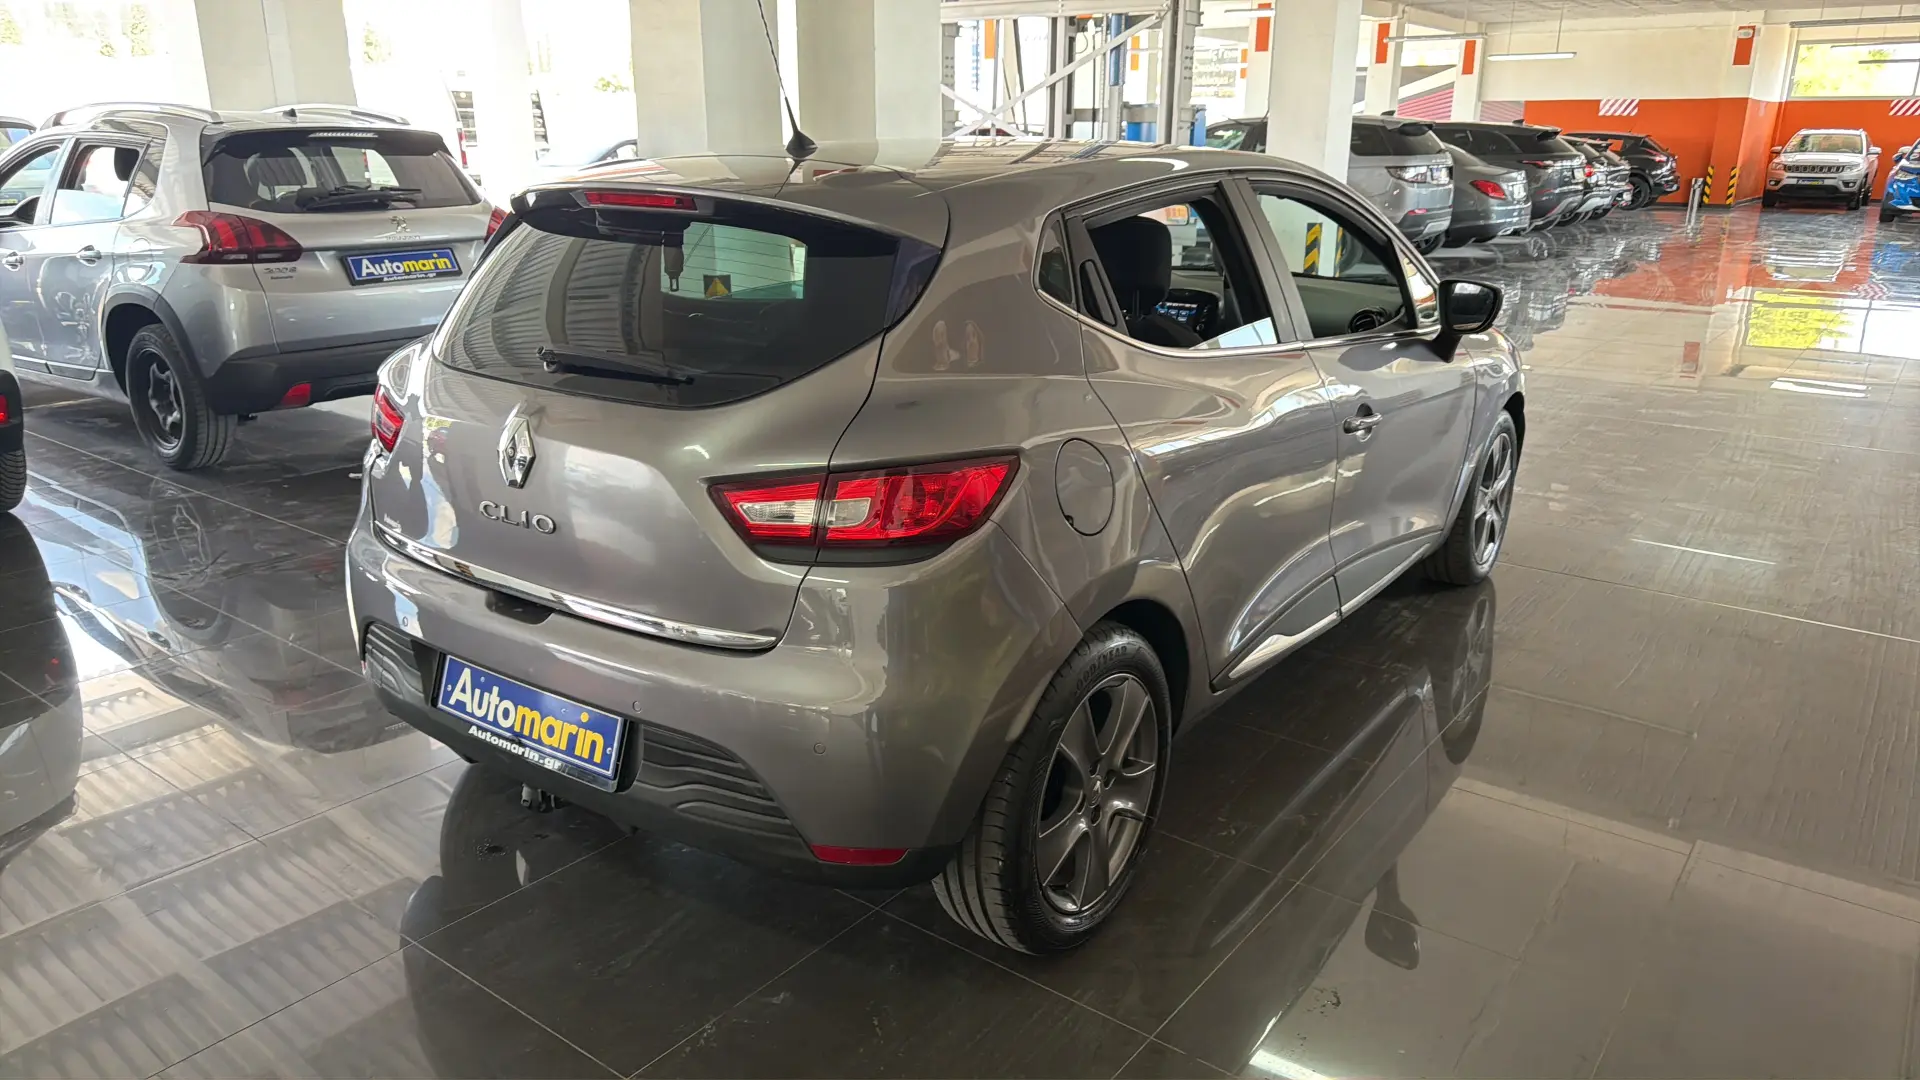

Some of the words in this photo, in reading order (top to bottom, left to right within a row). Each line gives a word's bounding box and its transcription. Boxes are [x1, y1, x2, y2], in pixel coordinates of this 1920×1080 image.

[361, 253, 452, 277] Automarin
[479, 500, 557, 535] CLIO
[448, 667, 604, 763] Automarin
[468, 725, 562, 771] Automarin.gr
